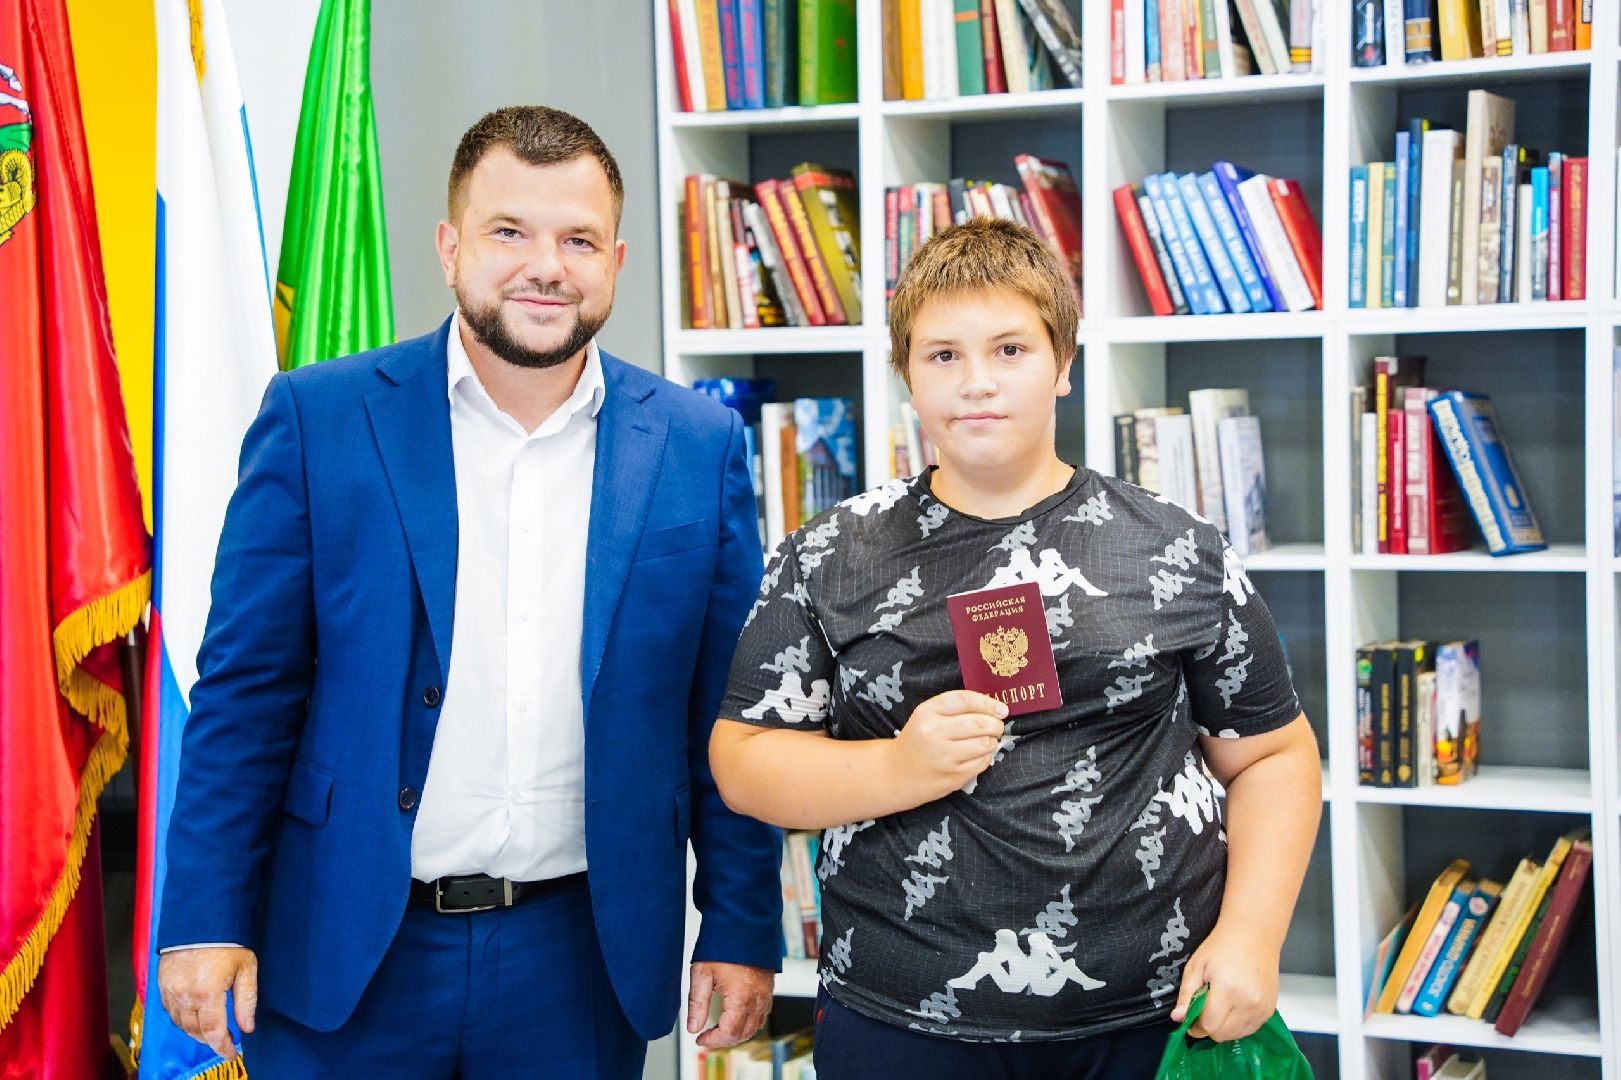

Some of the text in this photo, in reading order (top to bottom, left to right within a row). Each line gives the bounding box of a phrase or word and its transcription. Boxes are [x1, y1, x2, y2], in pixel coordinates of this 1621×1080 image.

[965, 596, 1026, 615] РОССИЙСКАЯ
[972, 606, 1024, 622] ФЕДЕРАЦИЯ
[986, 682, 1045, 705] АСПОРТ
